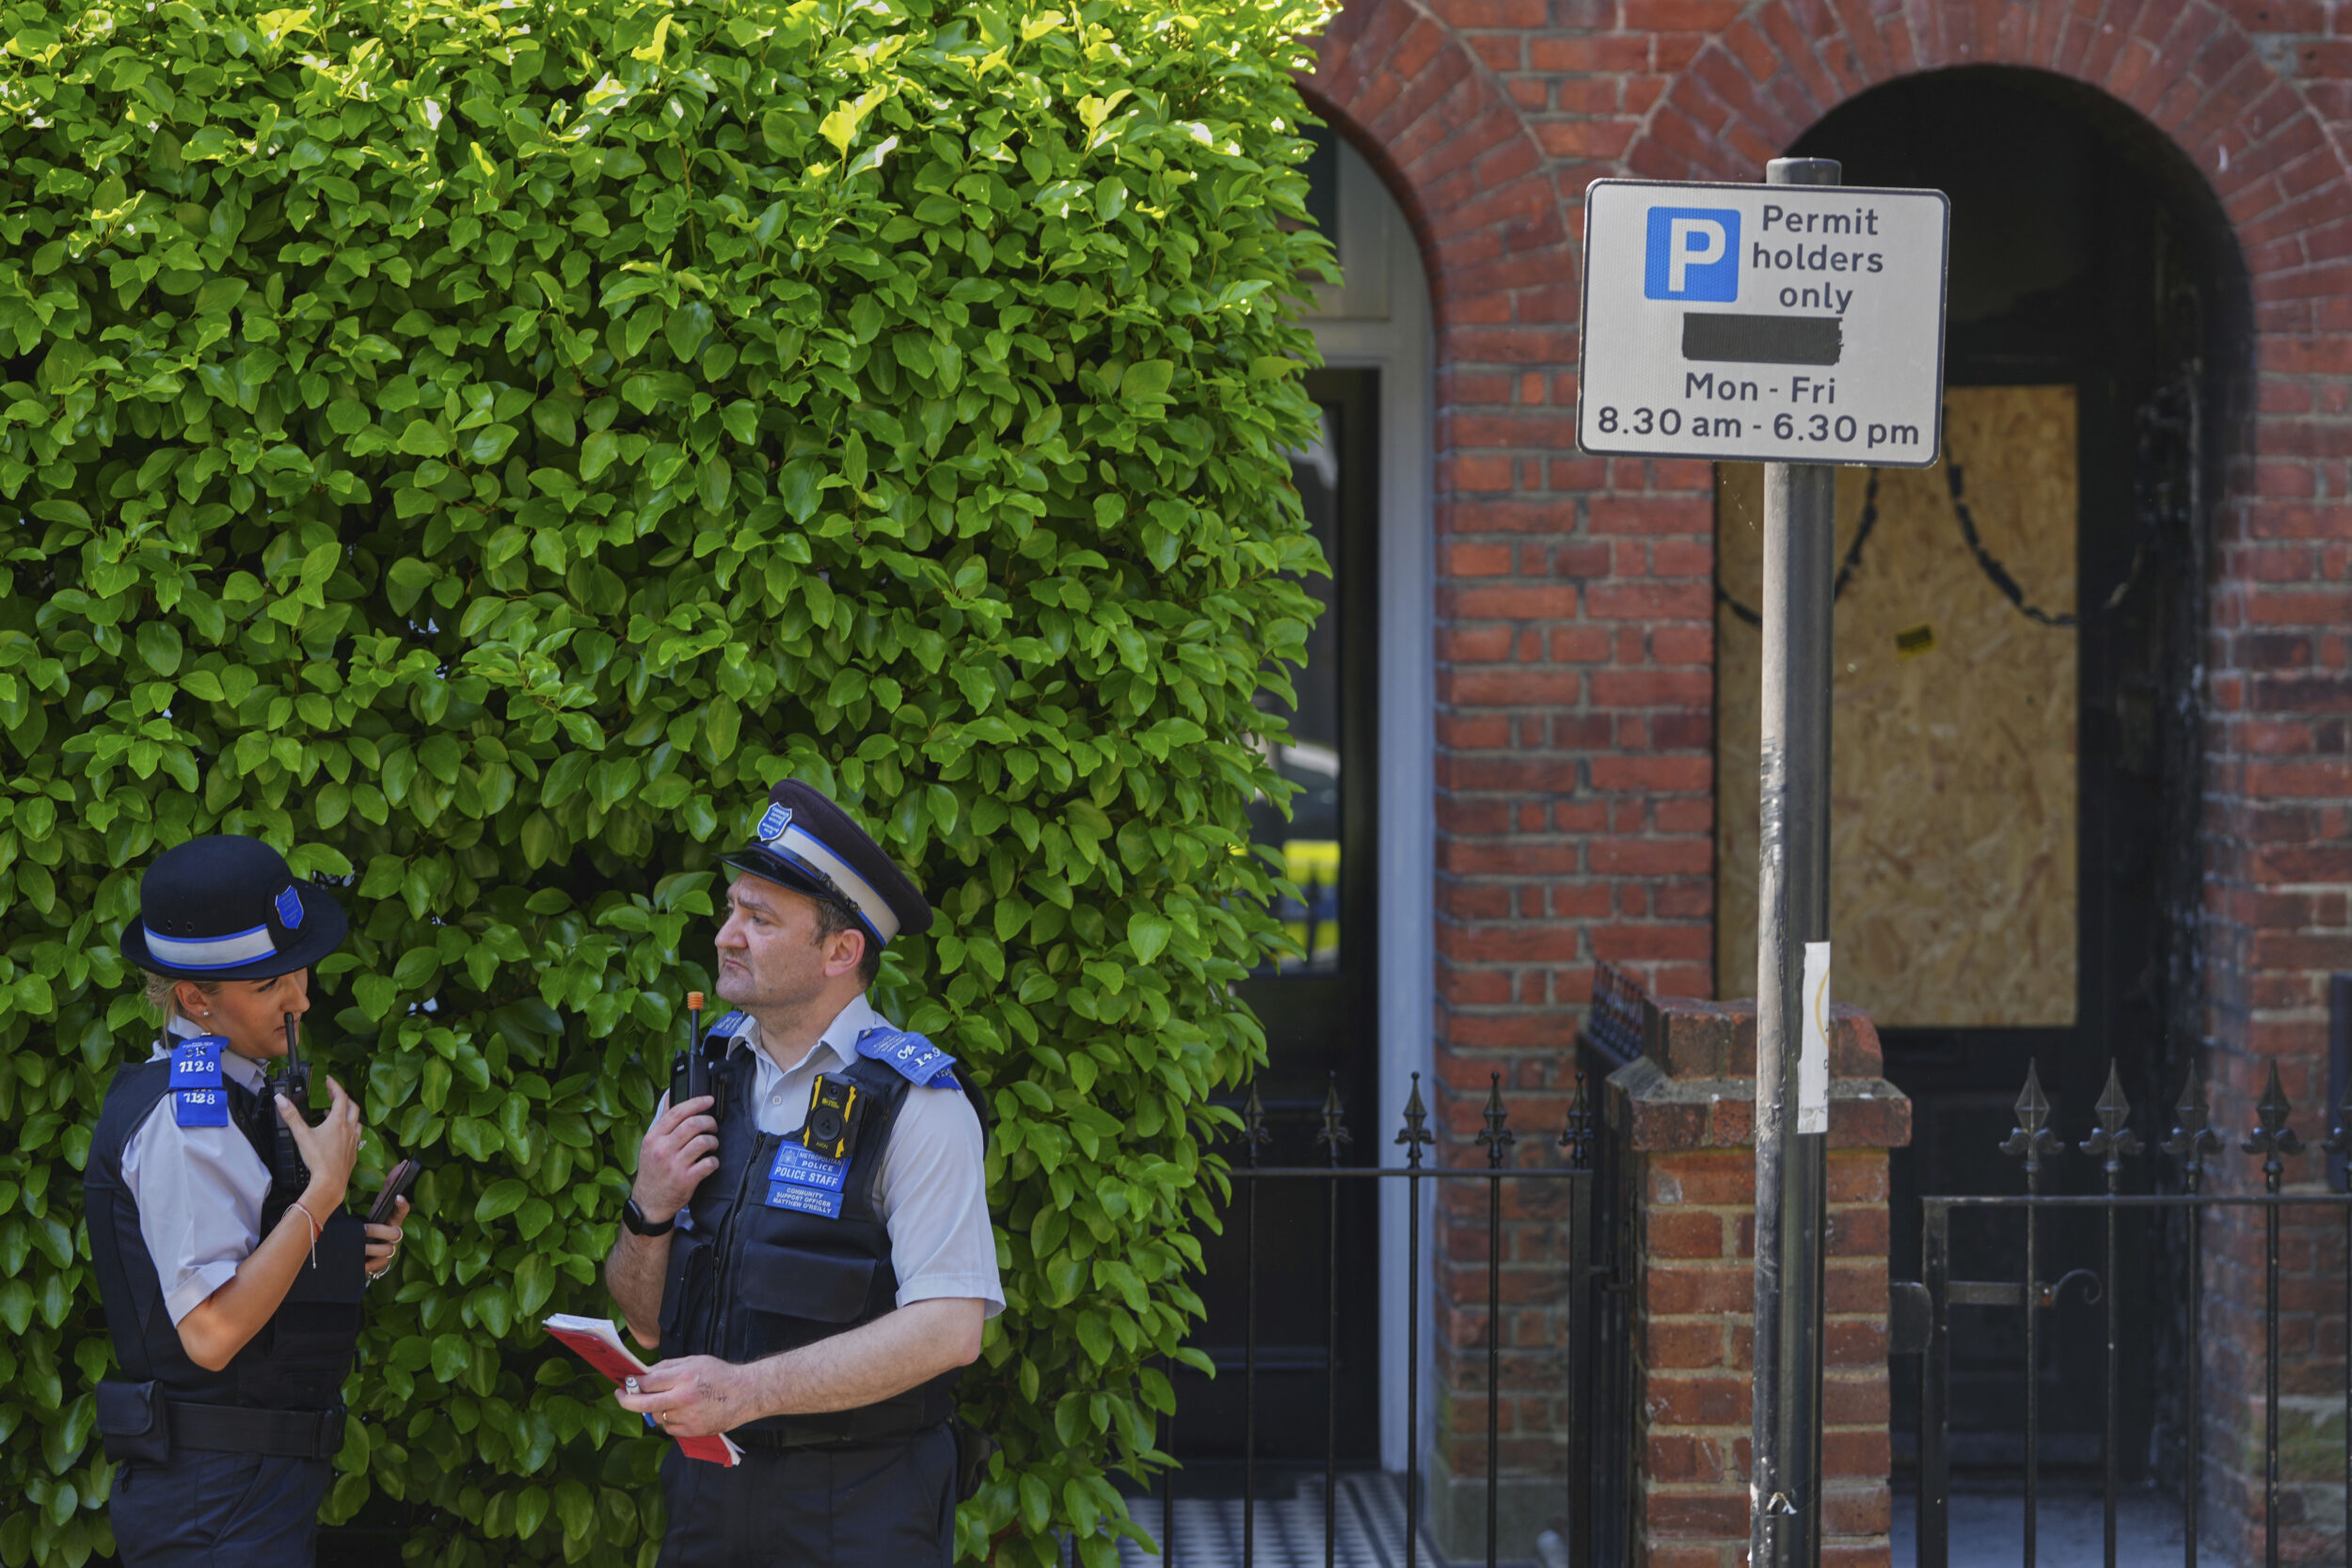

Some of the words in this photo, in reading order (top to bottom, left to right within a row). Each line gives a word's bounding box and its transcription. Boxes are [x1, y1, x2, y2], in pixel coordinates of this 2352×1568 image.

[1762, 204, 1879, 236] Permit
[1668, 217, 1726, 292] P
[1753, 242, 1883, 273] holders
[1779, 281, 1854, 314] only
[1685, 372, 1758, 402] Mon
[1791, 375, 1836, 404] Fri
[1598, 406, 1681, 436] 8.30
[1692, 415, 1741, 437] am
[1773, 413, 1856, 442] 6.30
[1867, 423, 1918, 448] pm
[179, 1060, 215, 1073] 7128
[183, 1092, 215, 1105] 7128
[799, 1152, 842, 1166] METROPOLITAN
[802, 1160, 834, 1172] POLICE
[774, 1165, 807, 1181] POLICE
[808, 1172, 838, 1187] STAFF
[776, 1191, 803, 1202] SUPPORT
[803, 1196, 832, 1208] OFFICER
[786, 1187, 824, 1199] COMMUNITY
[772, 1196, 803, 1208] MATTHEW
[803, 1202, 832, 1214] O'REILLY
